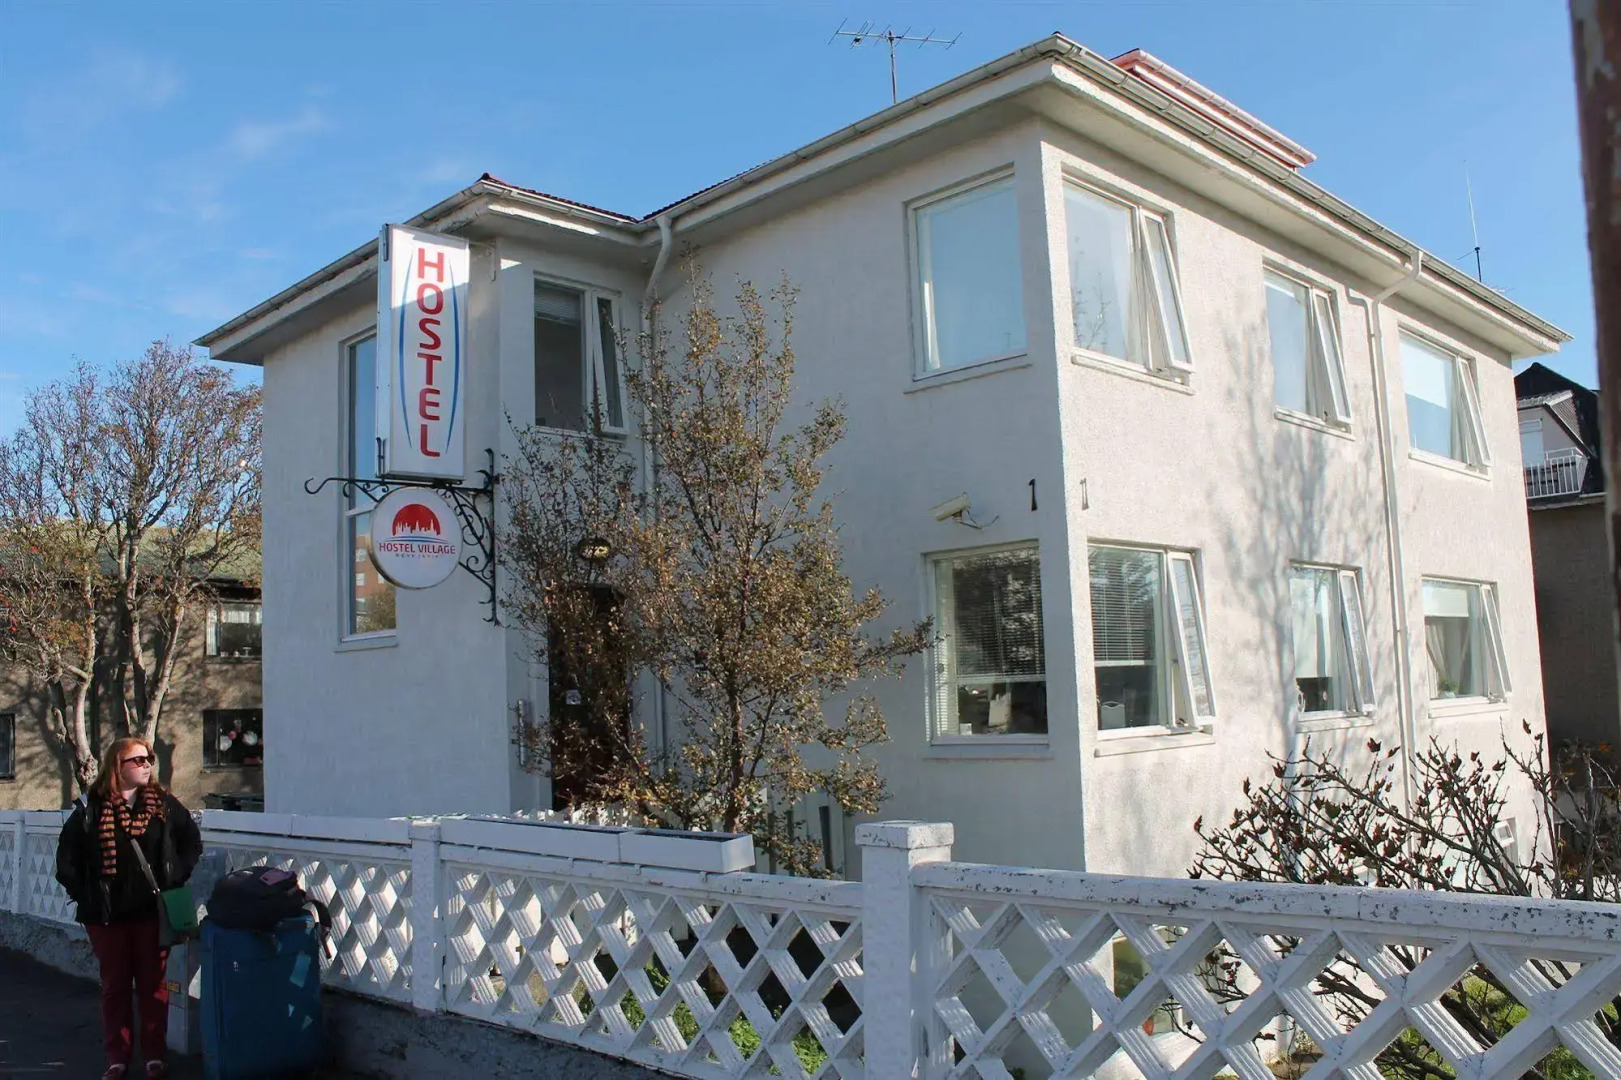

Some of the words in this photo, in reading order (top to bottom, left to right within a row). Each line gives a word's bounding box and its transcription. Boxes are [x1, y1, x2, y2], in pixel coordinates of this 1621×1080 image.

[416, 247, 446, 458] HOSTEL
[379, 542, 415, 553] HOSTEL
[417, 544, 456, 555] VILLAGE
